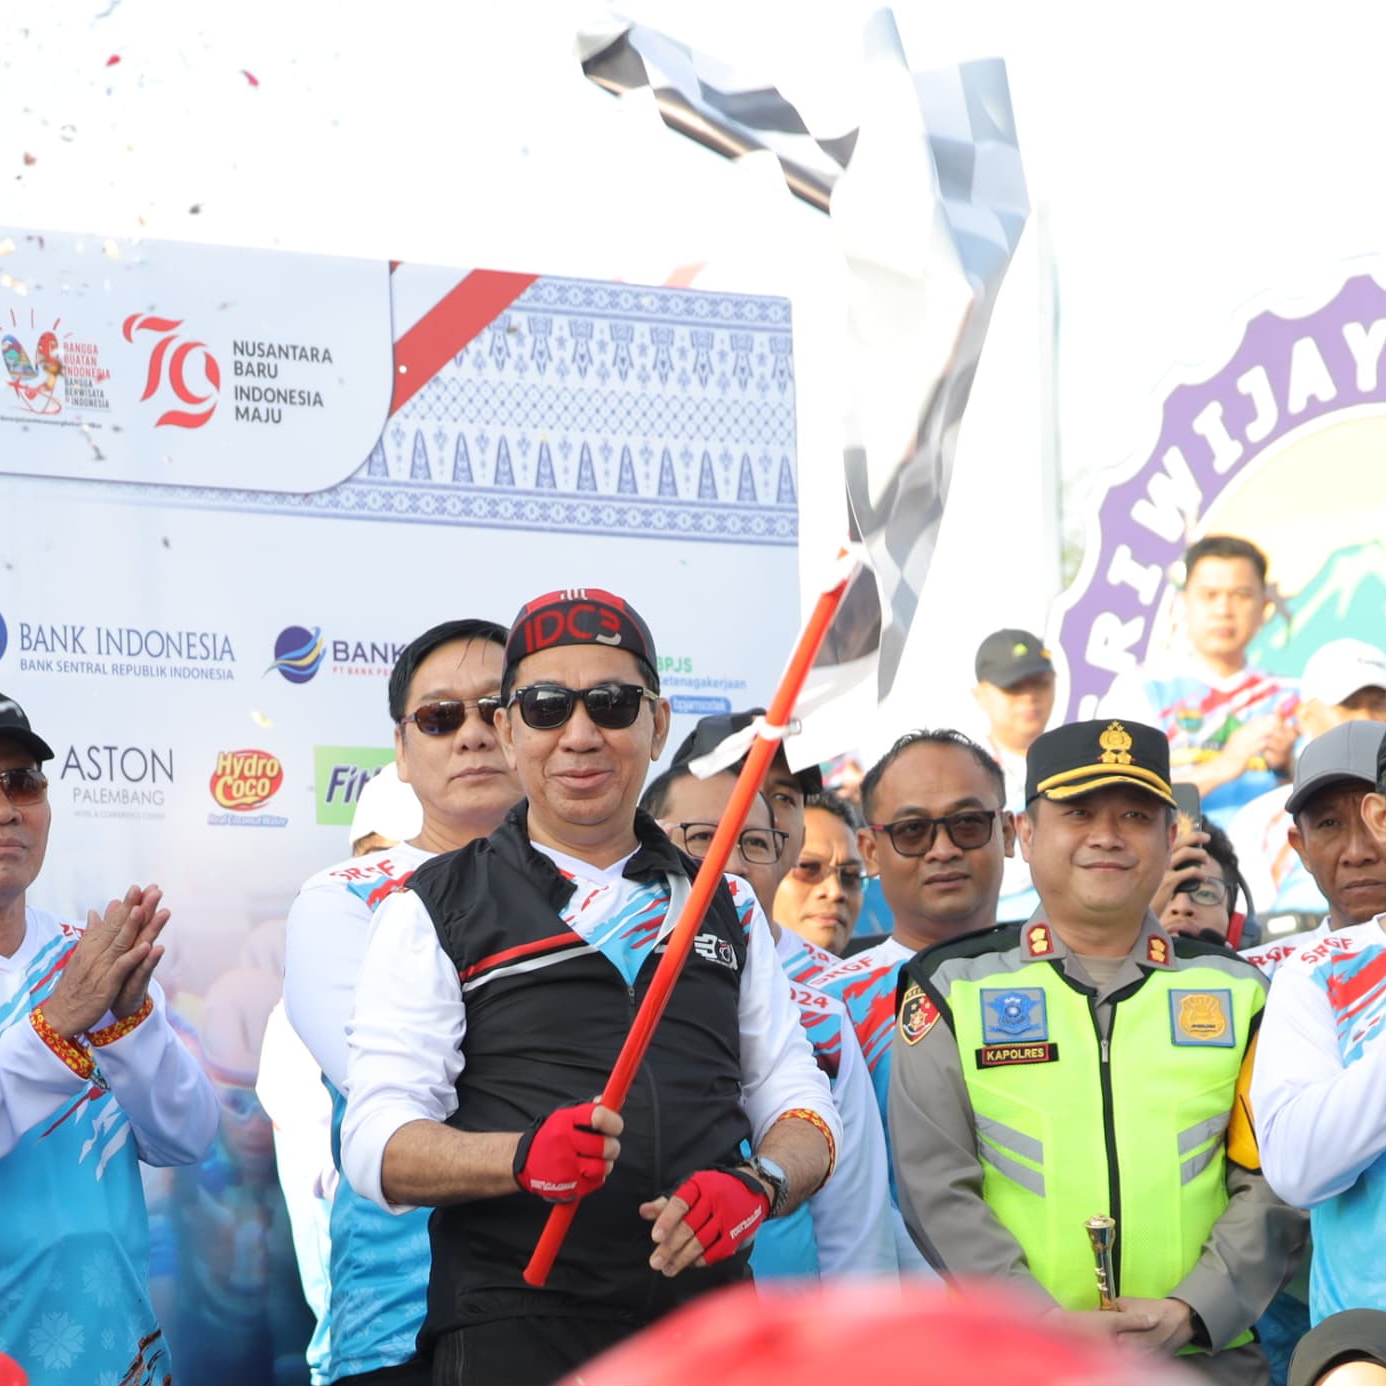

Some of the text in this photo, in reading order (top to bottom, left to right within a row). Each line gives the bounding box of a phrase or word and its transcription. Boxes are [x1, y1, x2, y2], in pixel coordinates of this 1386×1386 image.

[64, 342, 98, 354] BANGGA
[233, 340, 333, 364] NUSANTARA
[64, 354, 97, 366] BUATAN
[122, 312, 221, 429] 79
[234, 360, 278, 379] BARU
[64, 366, 110, 380] INDONESIA
[71, 399, 109, 408] INDONESIA
[234, 385, 324, 407] INDONESIA
[235, 406, 282, 424] MAJU
[20, 622, 236, 662] BANK INDONESIA
[333, 640, 406, 664] BANK
[20, 658, 234, 681] BANK SENTRAL REPUBLIK INDONESIA
[660, 676, 747, 691] etenagakerjaan
[61, 746, 174, 783] ASTON
[217, 751, 279, 778] Hydro
[73, 787, 165, 806] PALEMBANG
[215, 776, 271, 807] Coco
[1301, 937, 1354, 964] SRGF
[986, 1048, 1045, 1061] KAPOLRES
